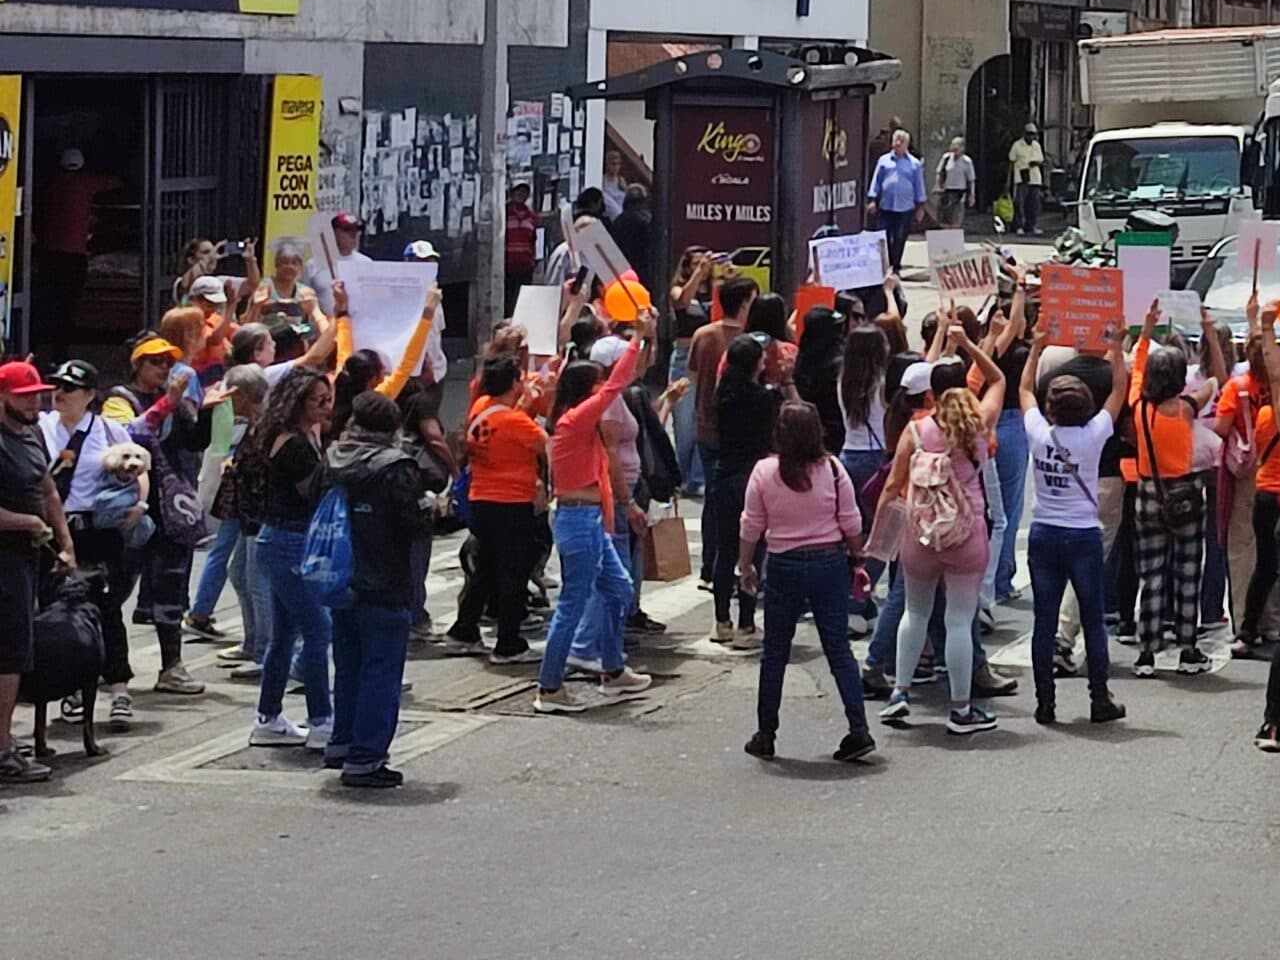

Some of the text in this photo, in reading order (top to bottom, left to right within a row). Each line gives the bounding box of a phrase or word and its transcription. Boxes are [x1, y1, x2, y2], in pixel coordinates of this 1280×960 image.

[277, 155, 313, 173] PEGA
[280, 174, 309, 191] CON
[273, 194, 313, 211] TODO.
[686, 203, 771, 222] MILES Y MILES
